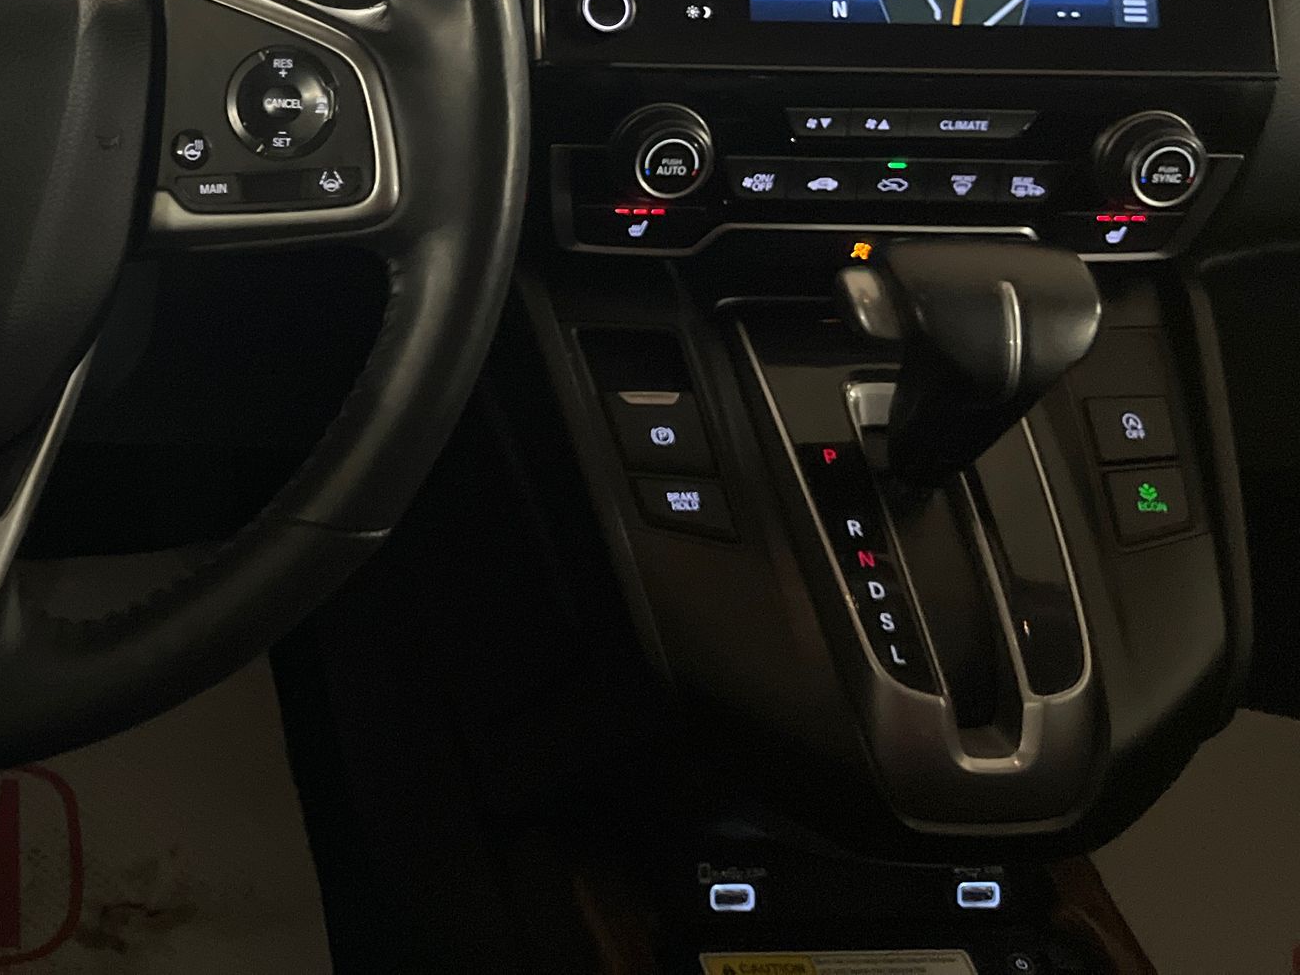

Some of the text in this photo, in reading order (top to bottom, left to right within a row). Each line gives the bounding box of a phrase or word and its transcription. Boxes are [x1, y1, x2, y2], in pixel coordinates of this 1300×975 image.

[832, 0, 848, 18] N
[273, 58, 293, 69] RES
[264, 98, 302, 109] CANCEL
[939, 119, 989, 131] CLIMATE
[272, 137, 292, 148] SET
[656, 165, 687, 176] AUTO
[1152, 173, 1182, 183] SYNC
[200, 183, 227, 194] MAIN
[752, 182, 773, 192] OFF
[822, 448, 837, 464] P
[666, 491, 700, 502] BRAKE
[846, 519, 864, 538] R
[857, 550, 876, 568] N
[867, 581, 886, 600] D
[879, 612, 896, 632] S
[890, 644, 907, 665] L
